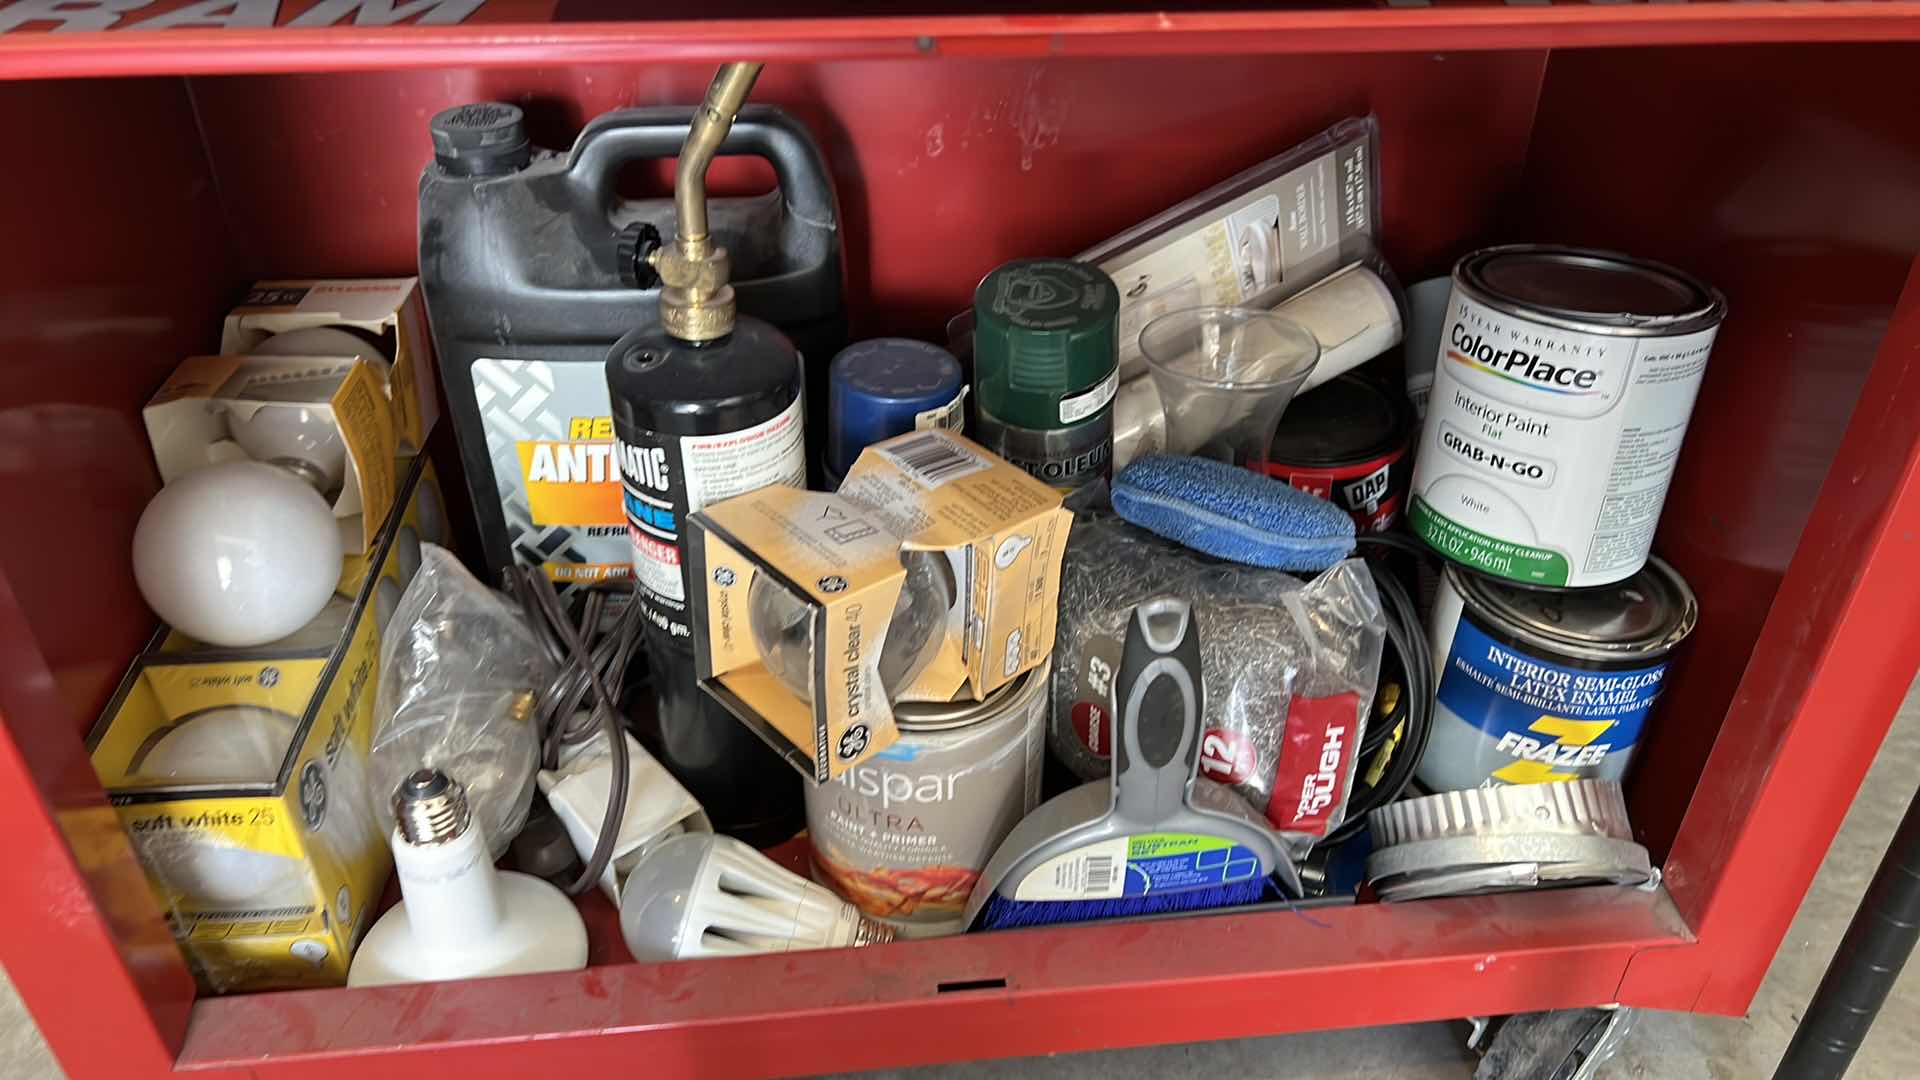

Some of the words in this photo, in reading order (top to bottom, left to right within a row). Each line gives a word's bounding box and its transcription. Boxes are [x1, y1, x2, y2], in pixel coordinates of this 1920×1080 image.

[1471, 313, 1501, 333] YEAR
[1510, 330, 1607, 358] WARRANTY
[1450, 322, 1598, 389] ColorPlace
[569, 416, 613, 440] RE
[1454, 390, 1503, 426] Interior
[1505, 413, 1551, 438] Paint
[1481, 422, 1503, 440] Flat
[527, 443, 622, 482] ANTI
[616, 437, 670, 492] MATIC
[1443, 431, 1544, 480] GRAB-N-GO
[1351, 471, 1386, 505] DAP
[1460, 493, 1490, 514] White
[587, 526, 629, 537] REFRI
[1447, 523, 1490, 548] APPLICATION
[845, 603, 863, 623] 40
[843, 624, 861, 661] clear
[1088, 655, 1112, 698] #3
[1488, 645, 1572, 688] INTERIOR
[1573, 664, 1666, 692] SEMI-GLOSS
[843, 664, 863, 718] crystal
[1510, 674, 1568, 703] LATEX
[1571, 689, 1638, 706] ENAMEL
[1585, 706, 1616, 716] LATEX
[1201, 733, 1238, 776] 12
[1495, 731, 1612, 767] FRAZEE
[840, 766, 976, 808] lspar
[1291, 773, 1317, 824] YPER
[132, 815, 173, 832] soft
[181, 808, 245, 829] white
[248, 807, 275, 827] 25
[837, 793, 925, 832] ULTRA
[881, 832, 938, 846] PRIMER
